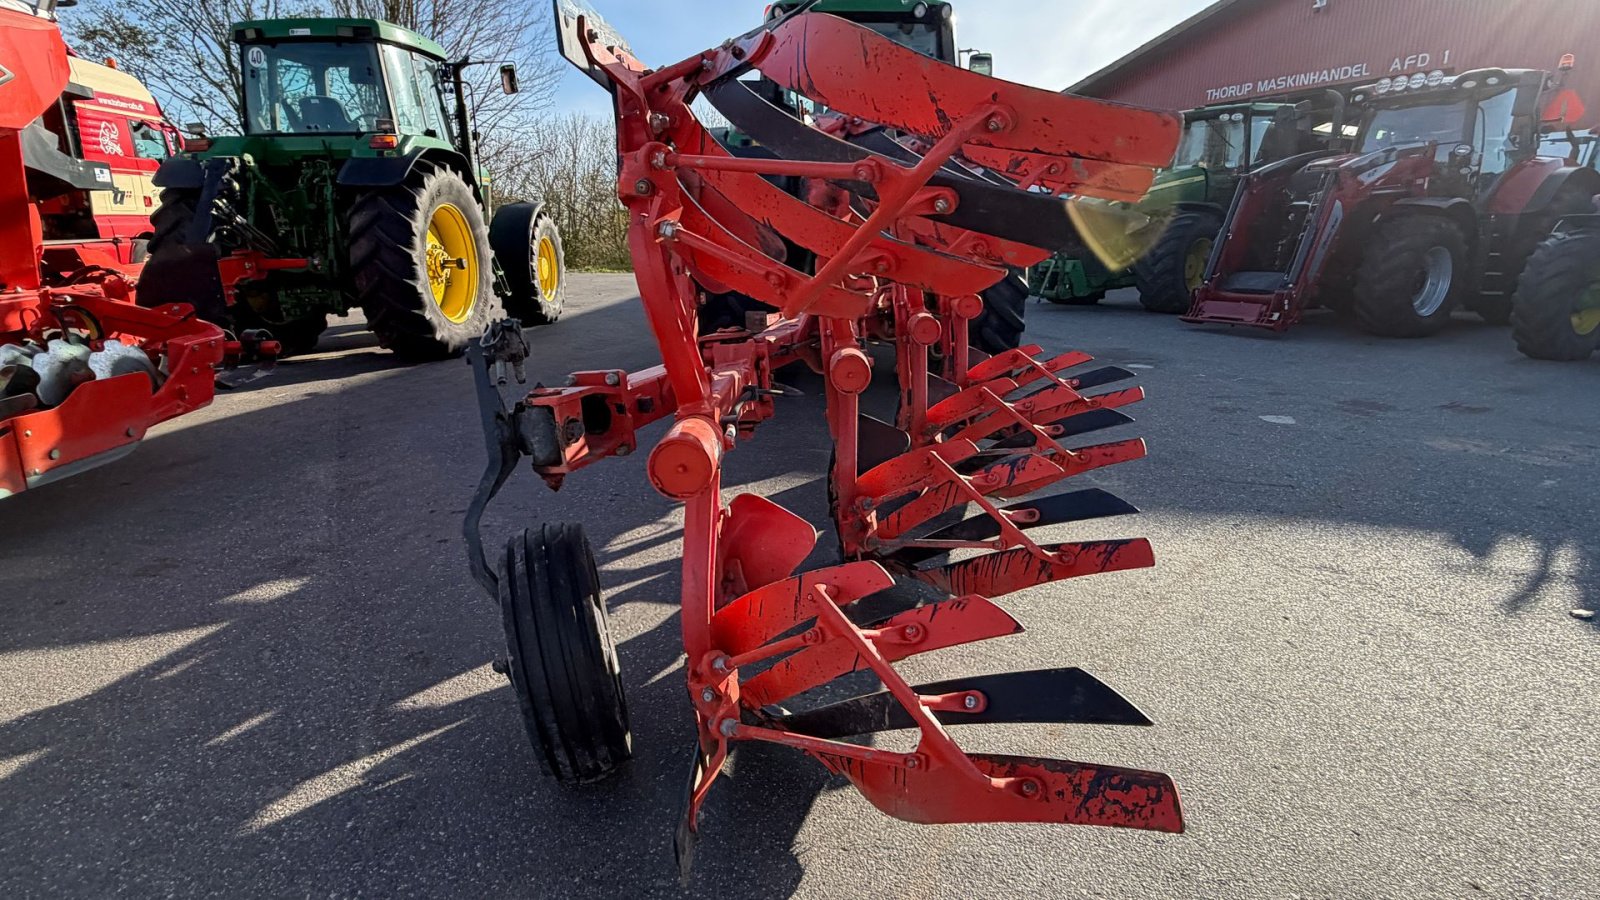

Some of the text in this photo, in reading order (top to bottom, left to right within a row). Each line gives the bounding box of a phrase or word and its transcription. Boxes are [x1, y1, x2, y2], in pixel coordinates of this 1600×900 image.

[251, 50, 262, 64] 40
[1206, 83, 1253, 101] THORUP
[1257, 63, 1370, 93] MASKINHANDEL
[1389, 53, 1430, 72] AFD
